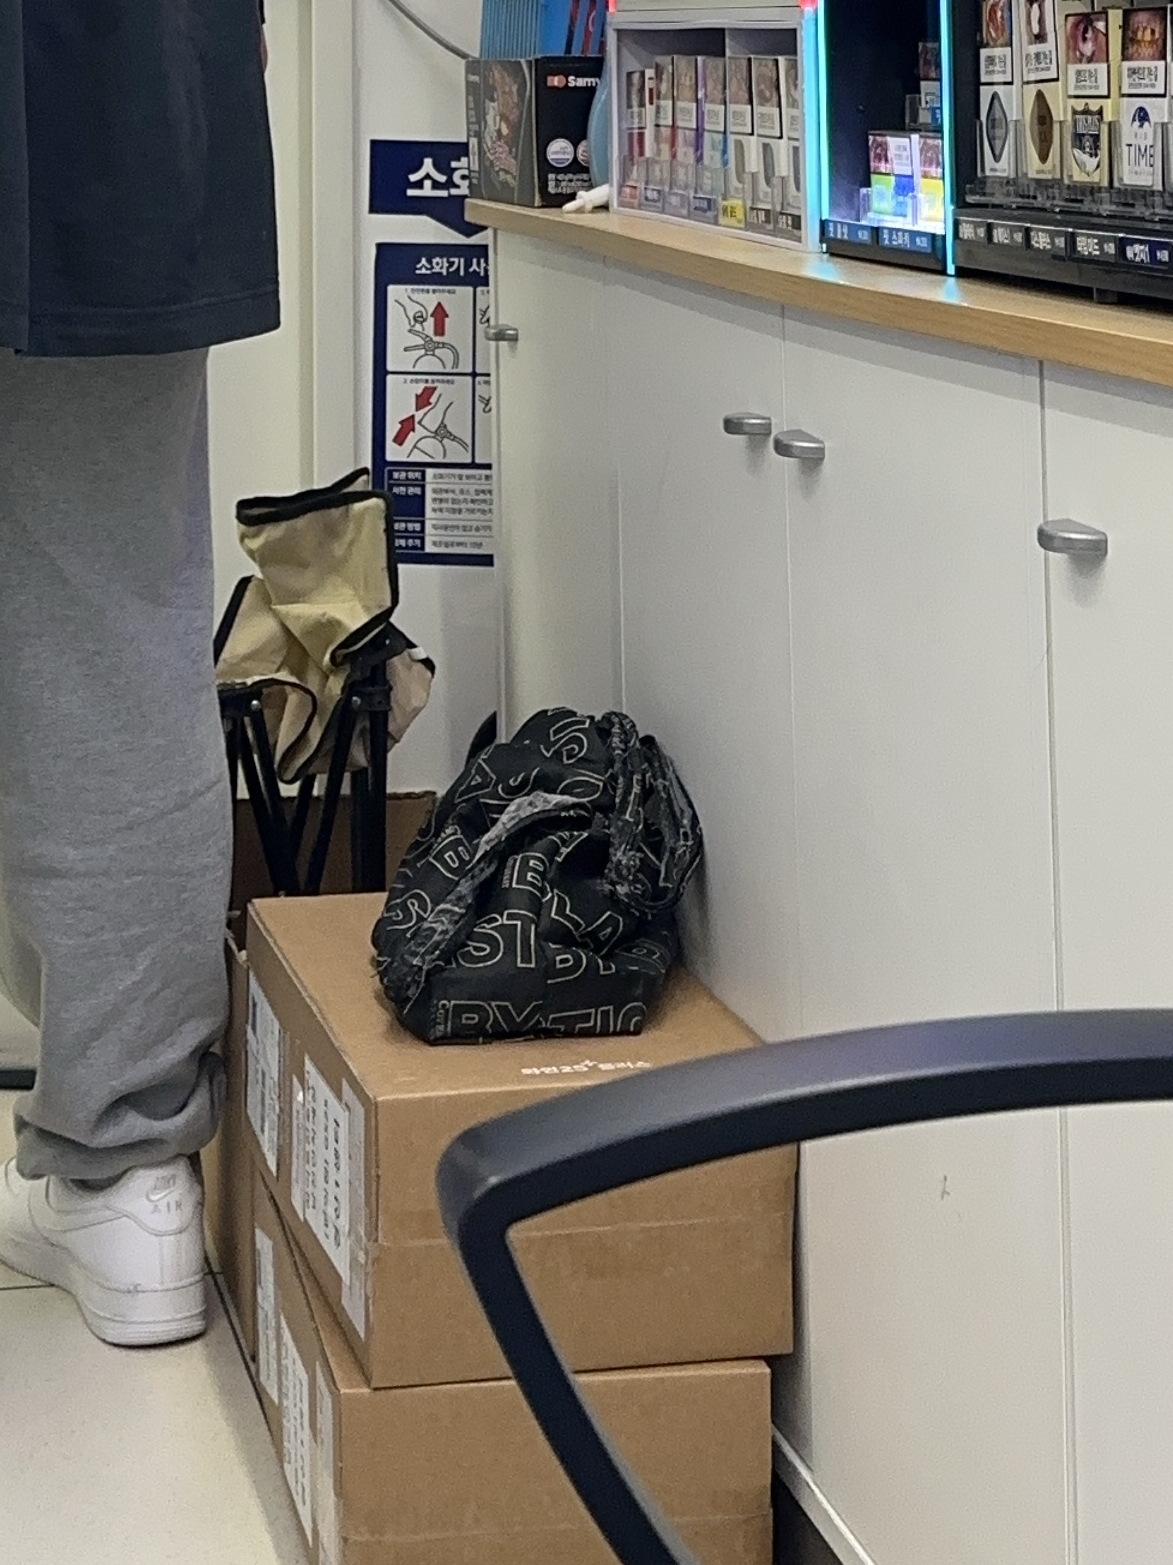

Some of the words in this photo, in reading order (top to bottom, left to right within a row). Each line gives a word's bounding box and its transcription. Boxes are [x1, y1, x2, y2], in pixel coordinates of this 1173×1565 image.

[1125, 143, 1154, 168] TIME
[415, 256, 464, 277] 소화기
[469, 257, 489, 277] 사
